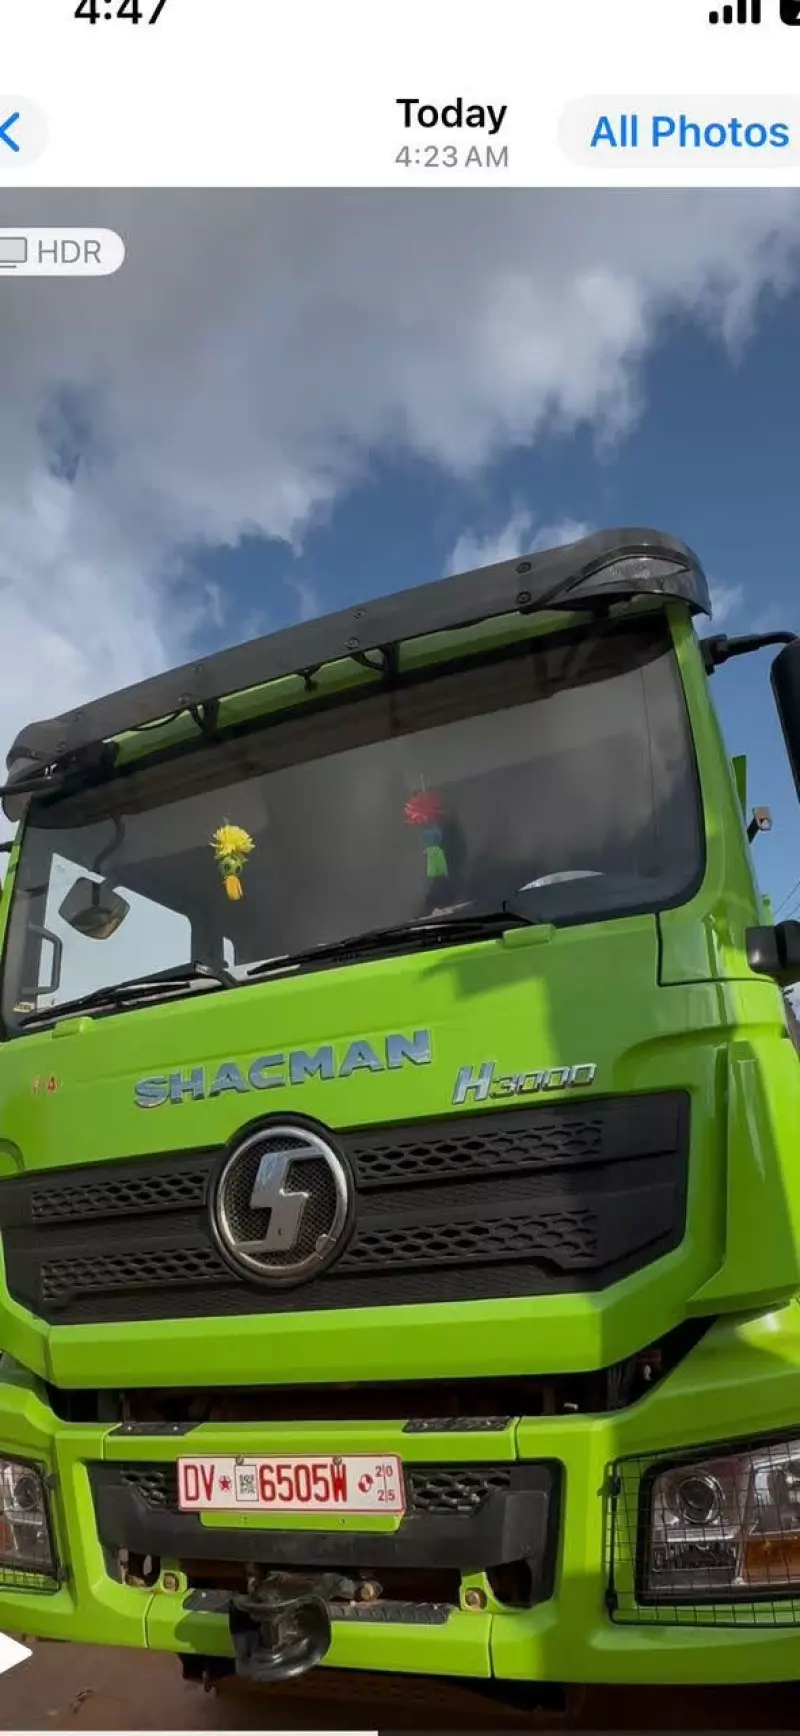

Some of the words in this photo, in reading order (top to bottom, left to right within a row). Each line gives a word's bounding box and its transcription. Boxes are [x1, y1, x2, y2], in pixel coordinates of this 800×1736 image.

[134, 1029, 432, 1108] SHACMAN
[452, 1060, 597, 1105] H3000
[183, 1464, 215, 1501] DV
[258, 1464, 347, 1502] 6505W
